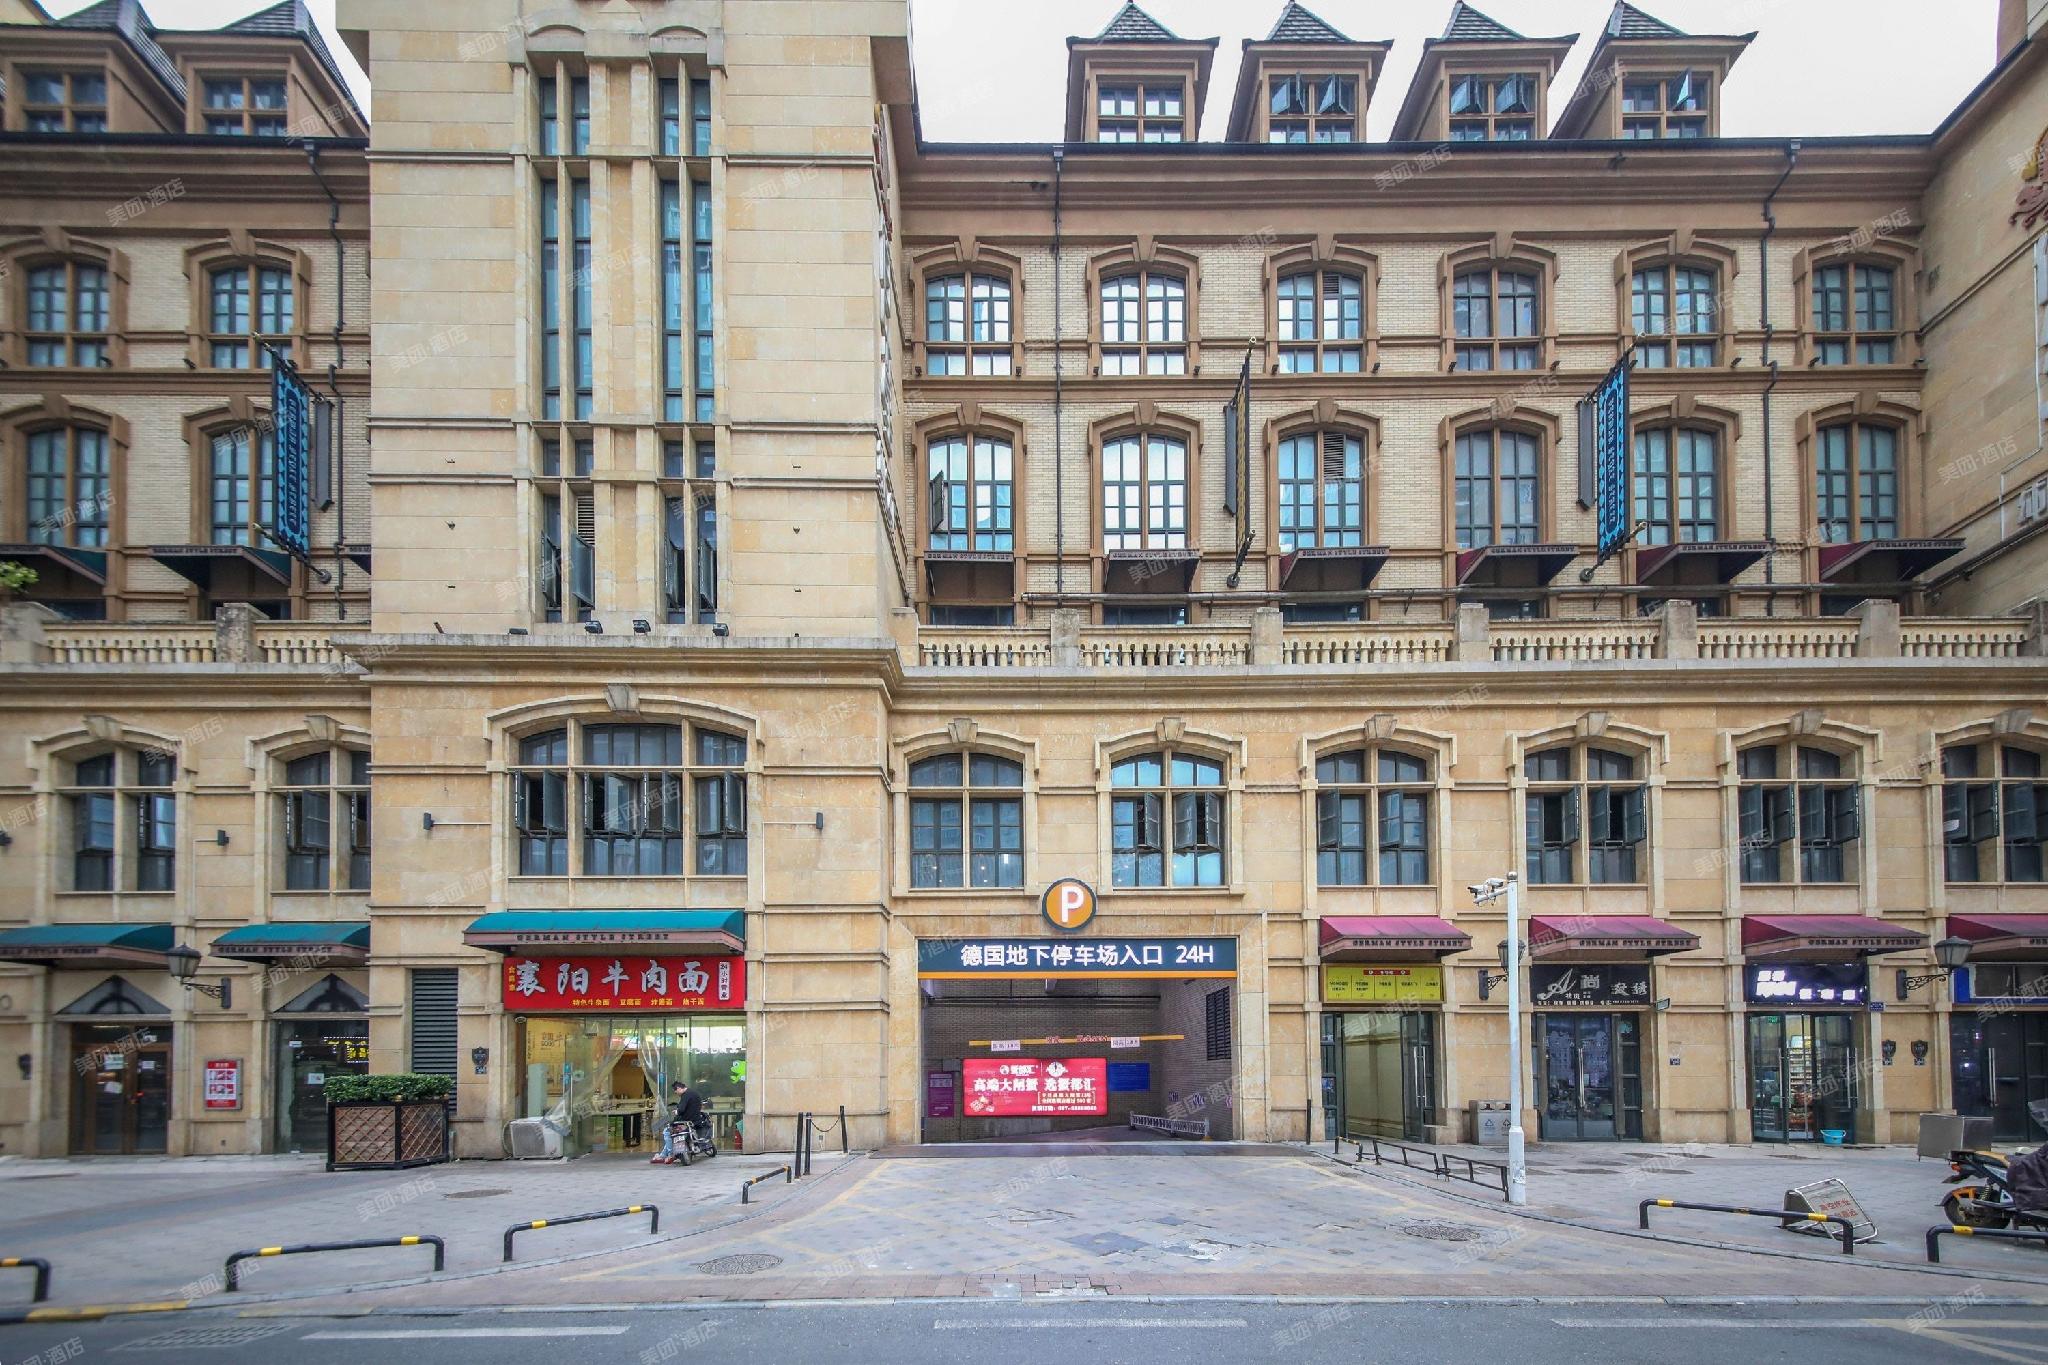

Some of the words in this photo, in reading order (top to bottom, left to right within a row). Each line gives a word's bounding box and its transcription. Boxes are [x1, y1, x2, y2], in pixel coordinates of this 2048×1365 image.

[1061, 886, 1084, 923] P
[516, 934, 569, 942] GERMAN
[576, 934, 615, 942] STYLE
[621, 934, 669, 942] STREET
[1352, 939, 1392, 947] GERMAN
[1395, 939, 1425, 947] STYLE
[1428, 939, 1464, 947] STREET
[1579, 939, 1619, 947] GERMAN
[1622, 939, 1652, 947] STYLE
[1655, 939, 1692, 947] STREET
[1808, 938, 1849, 946] GERMAN
[1852, 938, 1882, 946] STYLE
[1885, 938, 1921, 946] STREET
[960, 944, 1163, 967] 德国地下停车场入口
[1175, 944, 1215, 964] 24H
[516, 959, 710, 997] 襄阳牛肉面
[973, 1077, 1038, 1092] 高端大闸蟹
